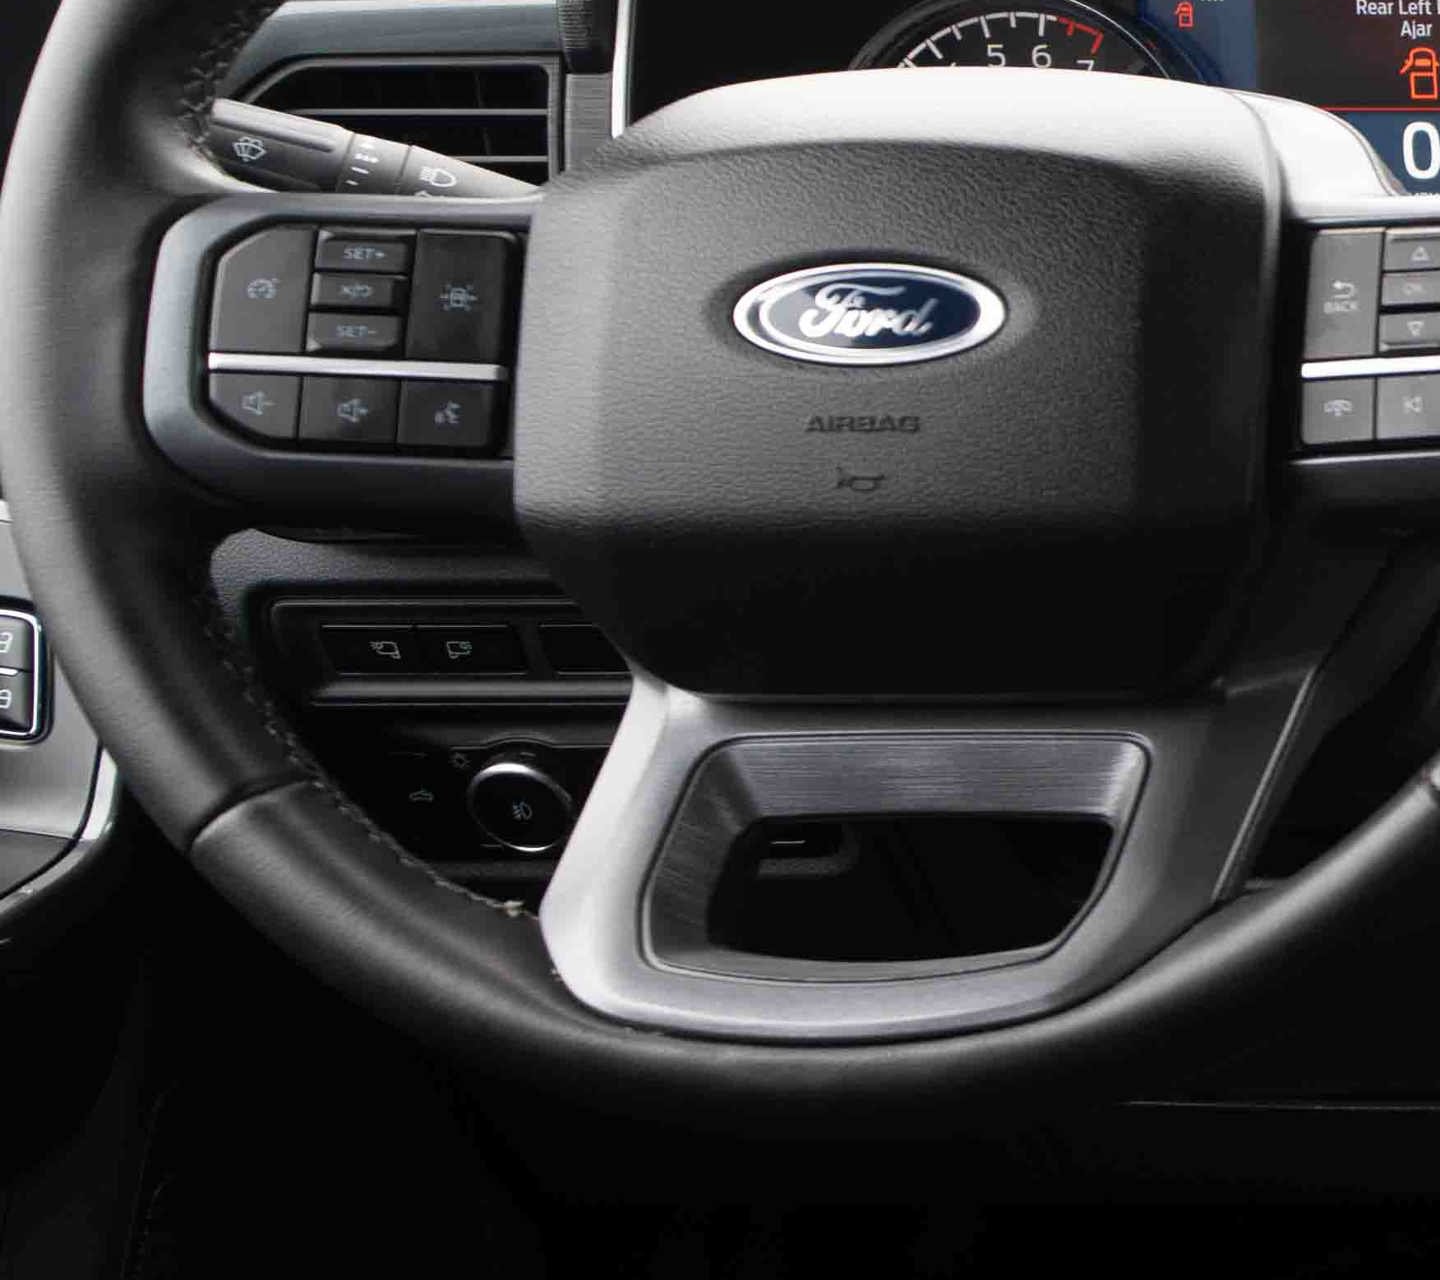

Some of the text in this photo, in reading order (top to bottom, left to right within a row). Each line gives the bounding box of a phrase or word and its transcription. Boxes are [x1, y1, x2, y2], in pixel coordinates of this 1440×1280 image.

[1400, 20, 1433, 40] Ajar
[987, 43, 1006, 67] 5
[1031, 44, 1052, 68] 6
[800, 282, 934, 339] Ford
[1323, 300, 1360, 314] BACK
[806, 414, 921, 435] AIRBAG
